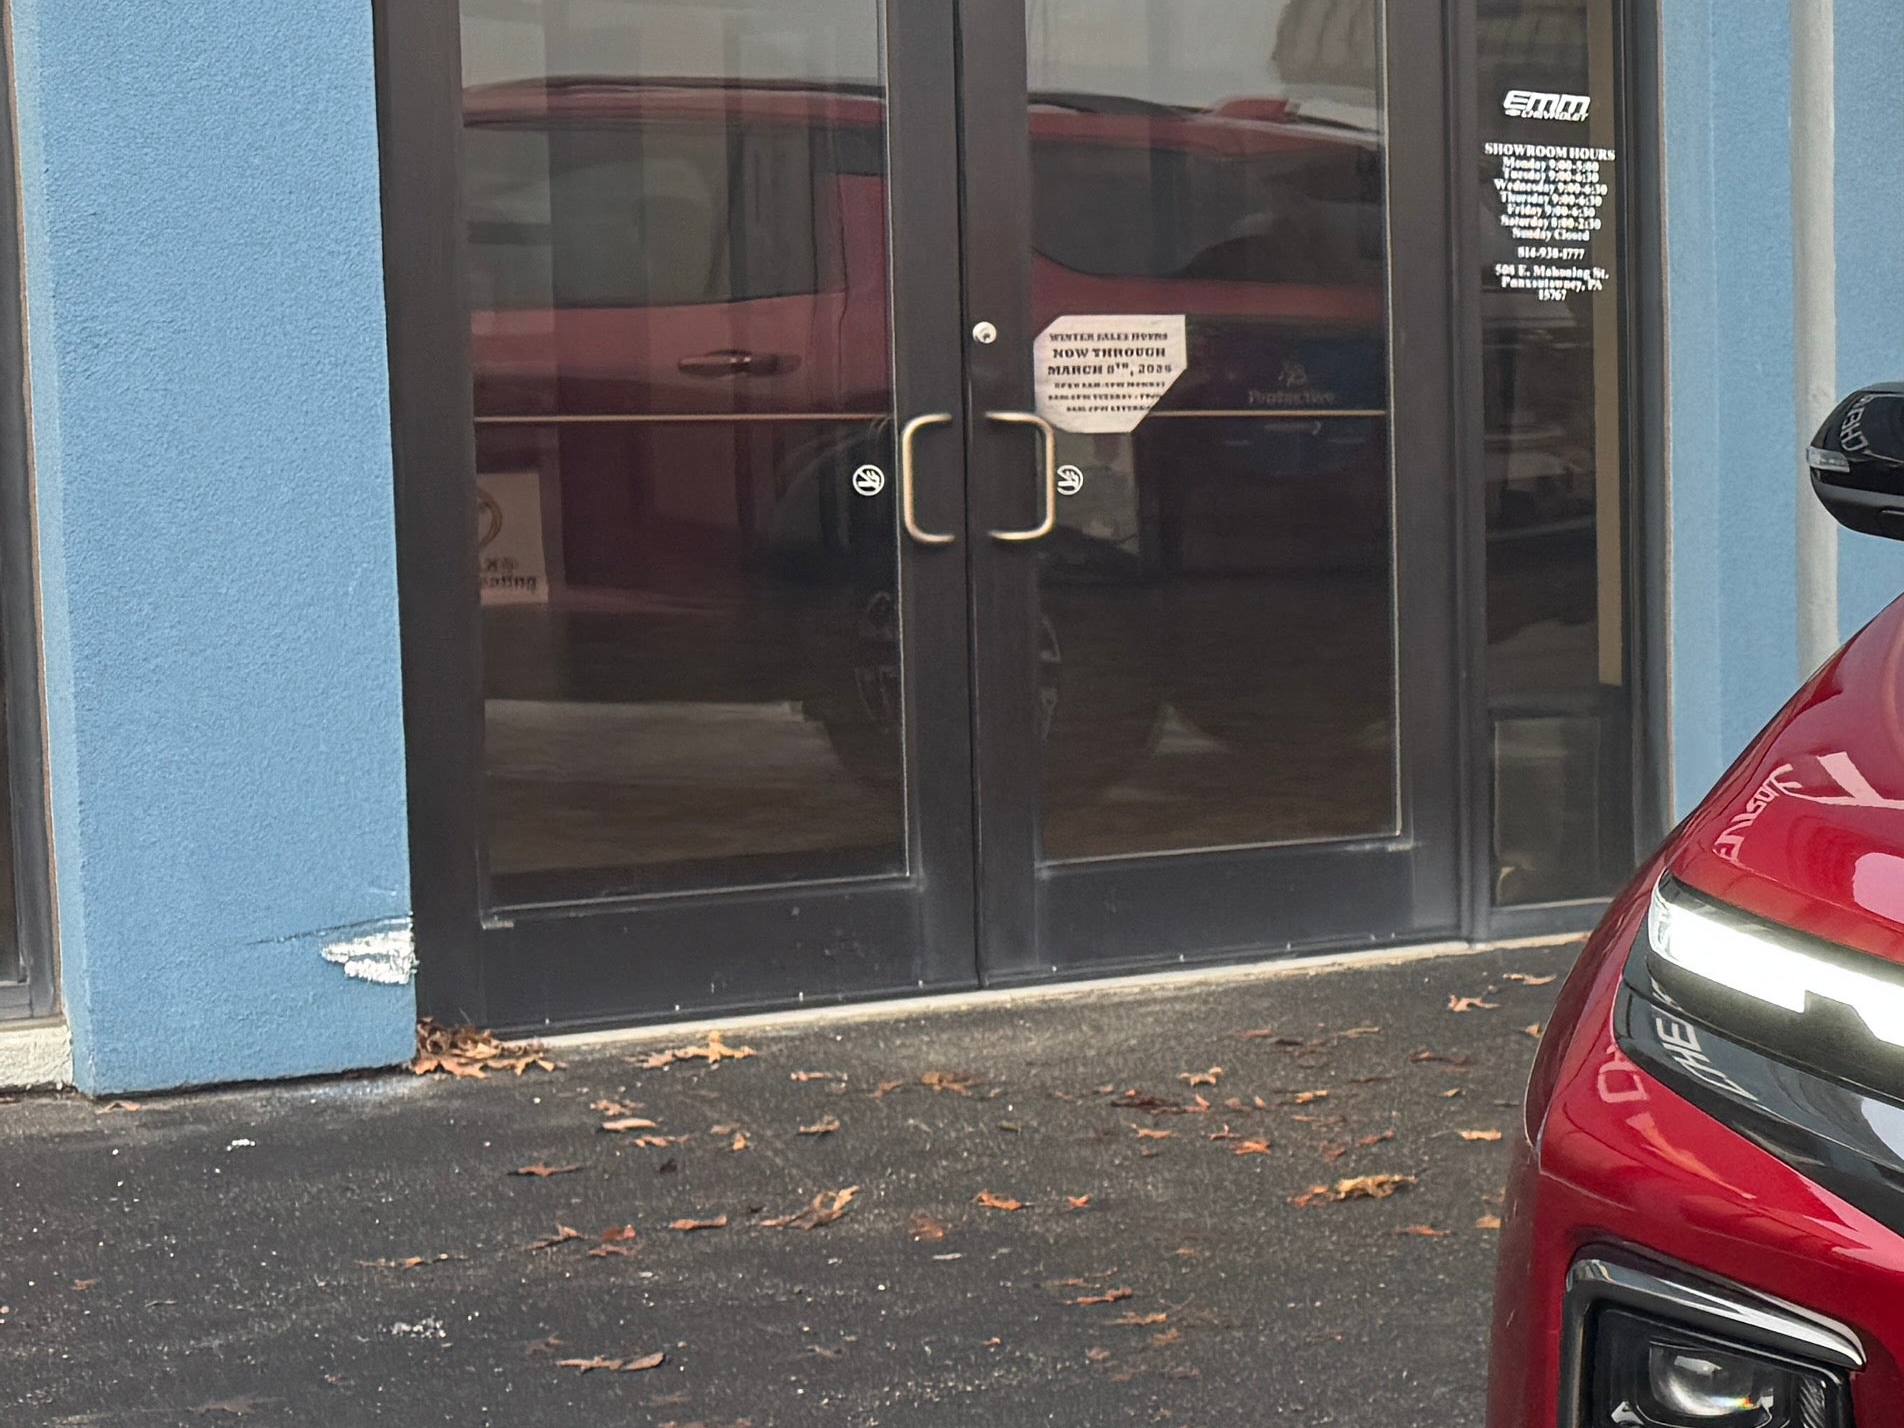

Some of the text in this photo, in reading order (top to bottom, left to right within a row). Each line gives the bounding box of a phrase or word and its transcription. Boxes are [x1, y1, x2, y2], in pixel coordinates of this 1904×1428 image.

[1484, 142, 1616, 161] SHOWROOM HOURS
[1502, 156, 1547, 172] Monday
[1049, 332, 1095, 342] WINTER
[1052, 347, 1166, 359] NOW THROUGH
[1047, 364, 1103, 376] MARCH
